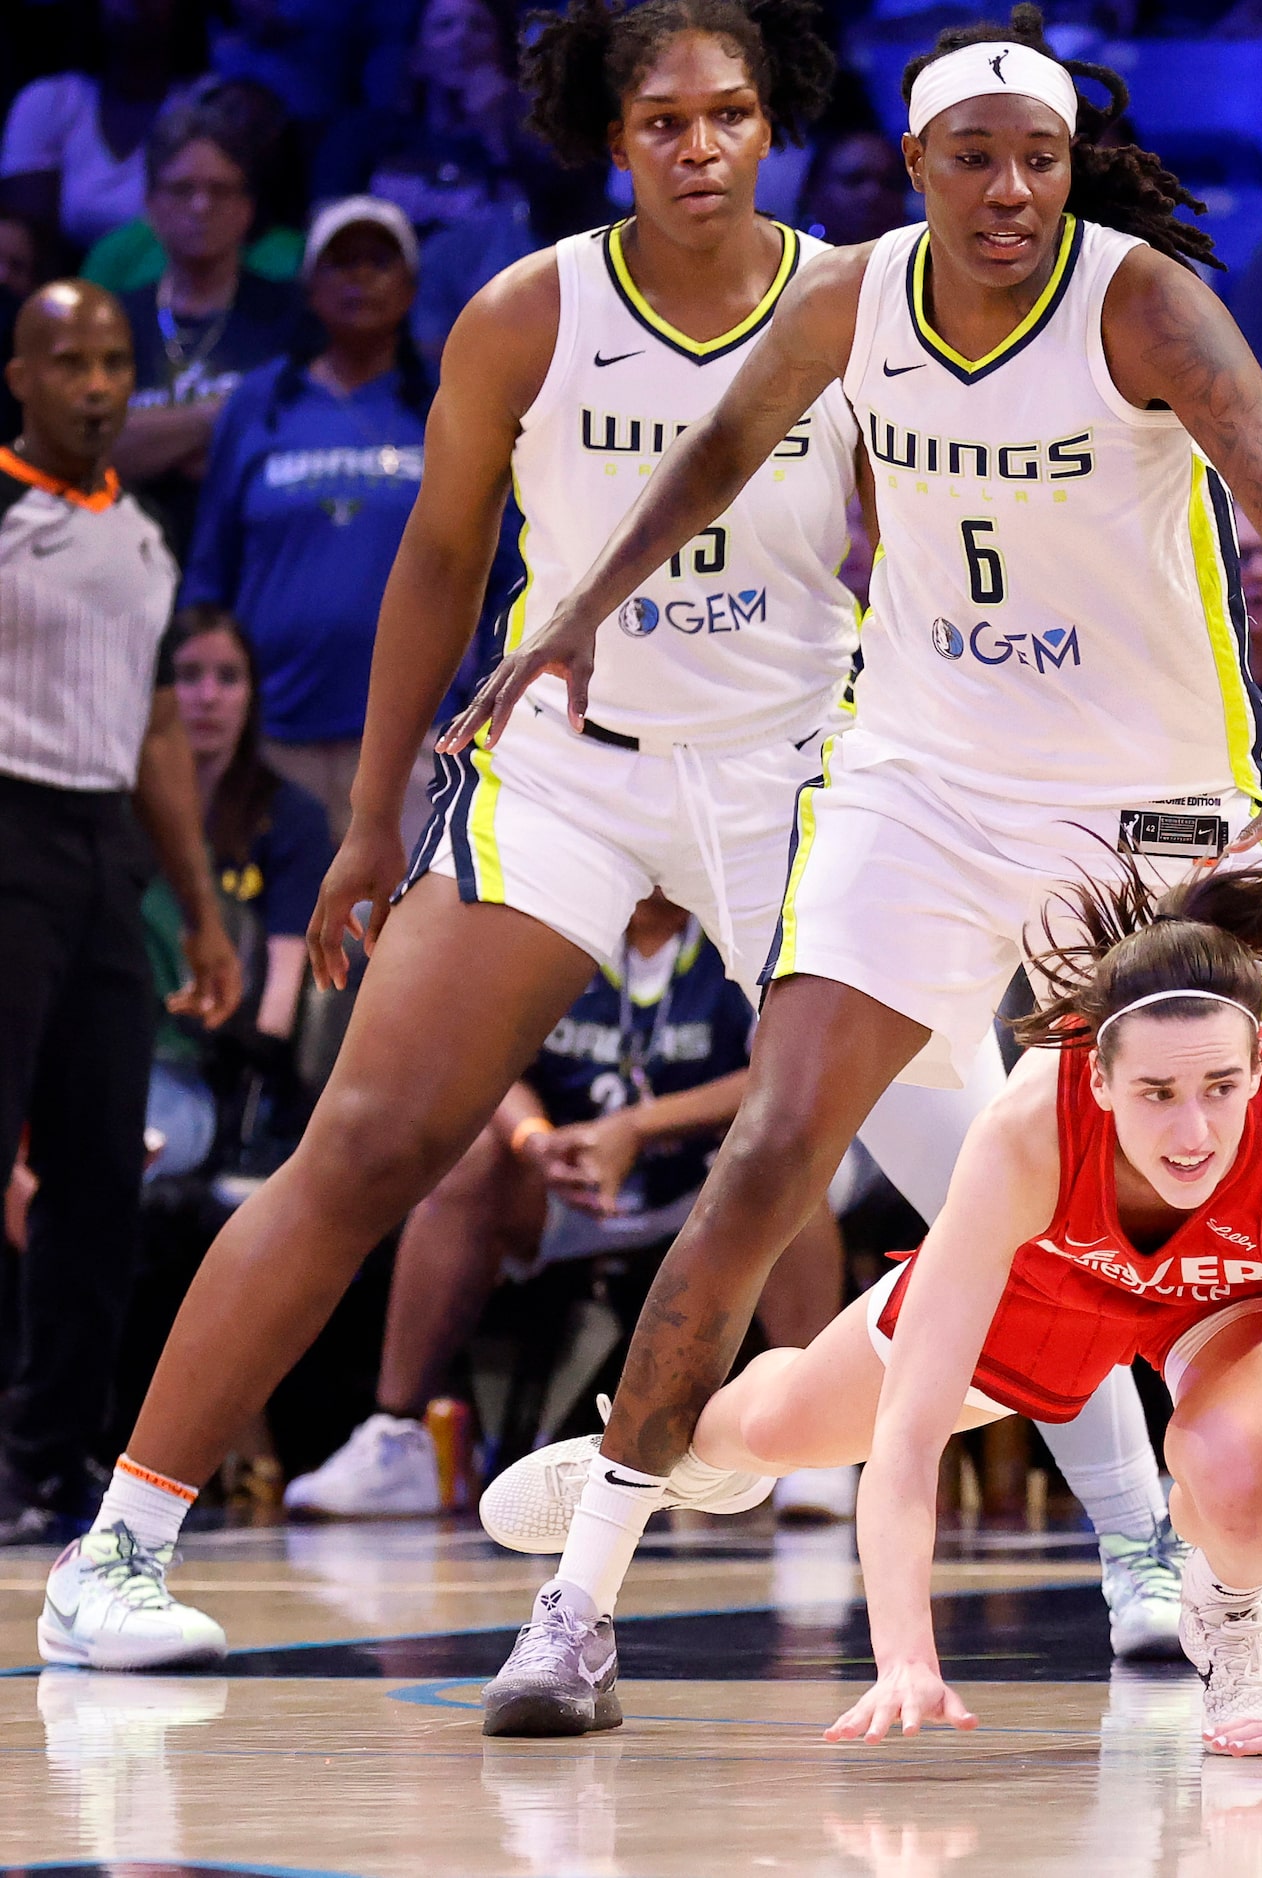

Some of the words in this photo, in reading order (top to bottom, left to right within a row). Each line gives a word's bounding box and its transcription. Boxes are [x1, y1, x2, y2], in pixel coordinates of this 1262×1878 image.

[582, 408, 812, 457] WIS
[869, 411, 1093, 481] WINGS
[887, 475, 1068, 504] DALLAS
[960, 520, 1005, 605] 6
[664, 591, 766, 635] GEM
[1145, 824, 1156, 833] 42
